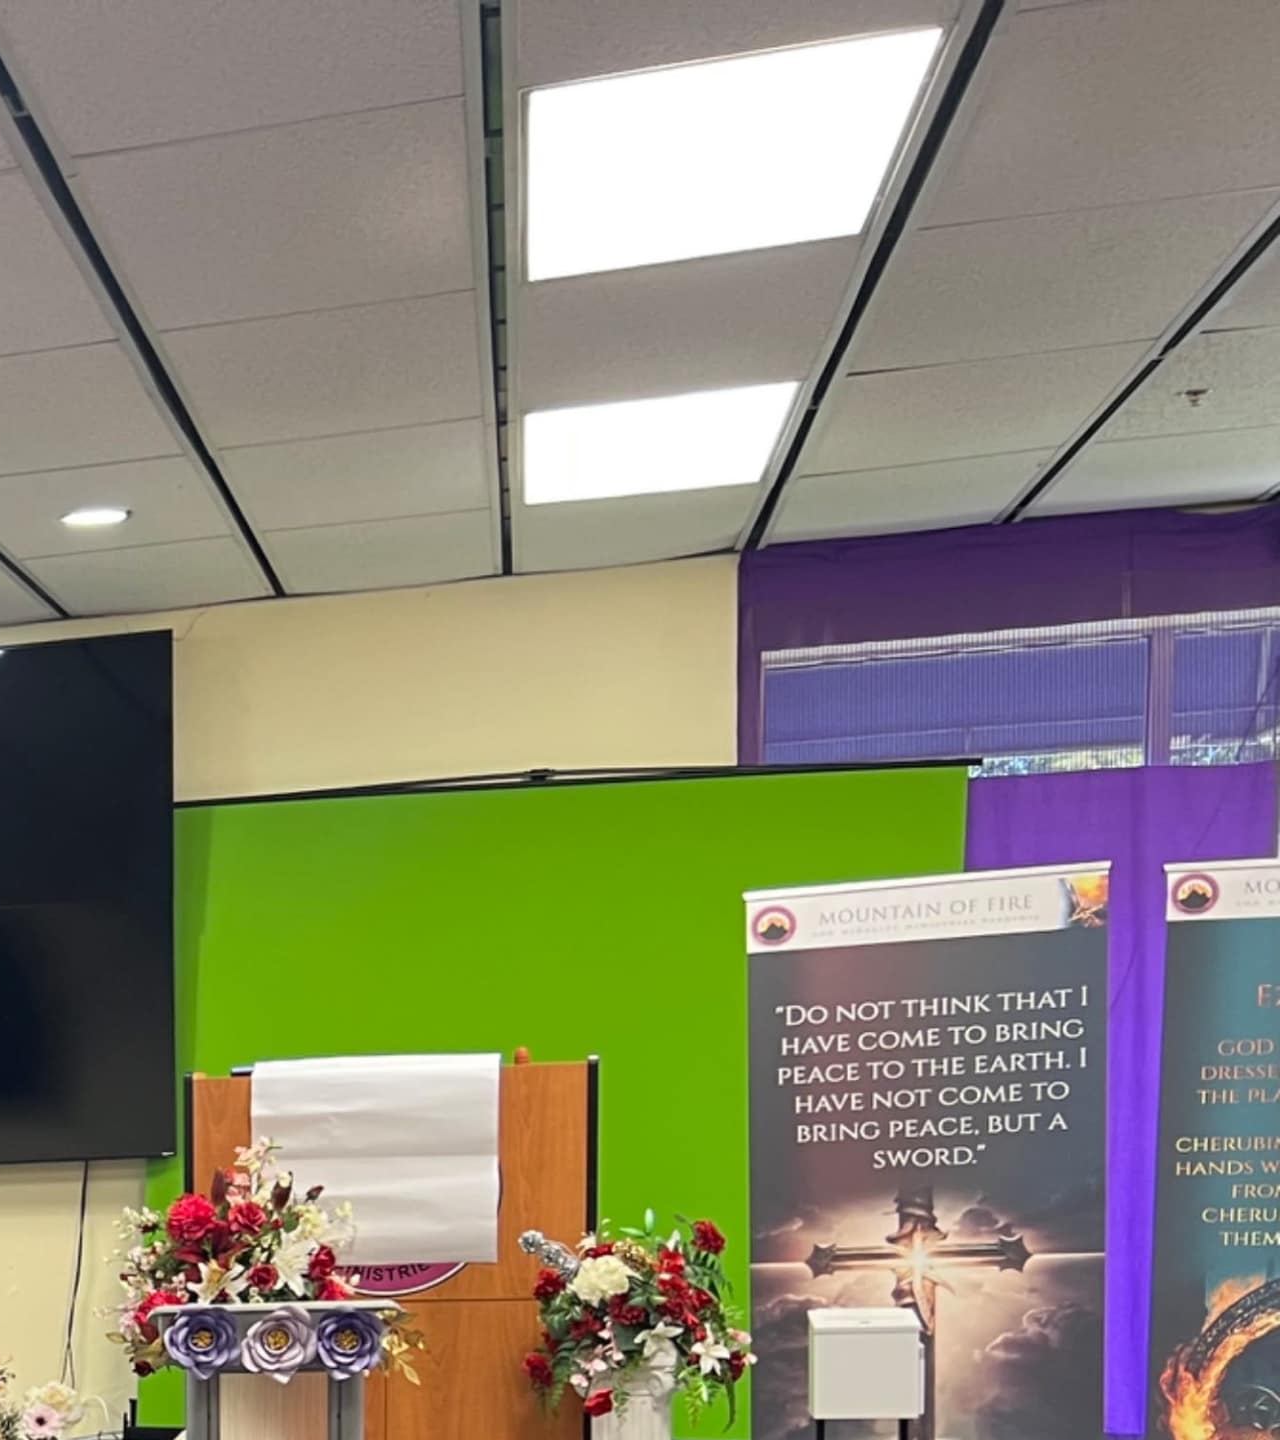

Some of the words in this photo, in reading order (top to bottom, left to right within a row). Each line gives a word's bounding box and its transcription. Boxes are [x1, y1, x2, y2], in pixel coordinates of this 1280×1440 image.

[819, 900, 942, 926] MOUNTAIN
[949, 898, 979, 915] OF
[986, 894, 1033, 913] FIRE
[835, 1001, 895, 1024] NOT
[901, 994, 991, 1018] THINK
[997, 988, 1073, 1012] THAT
[1080, 985, 1088, 1007] I
[781, 1034, 850, 1056] HAVE
[857, 1027, 941, 1051] COME
[947, 1024, 987, 1045] TO
[995, 1018, 1085, 1042] BRING
[1217, 1038, 1275, 1057] GOD
[777, 1063, 860, 1086] PEACE
[866, 1060, 905, 1081] TO
[911, 1056, 965, 1078] THE
[973, 1051, 1071, 1075] EARTH.
[1079, 1046, 1087, 1068] I
[795, 1092, 864, 1114] HAVE
[872, 1088, 931, 1110] NOT
[938, 1084, 1023, 1106] COME
[1029, 1081, 1071, 1101] TO
[1196, 1088, 1240, 1105] THE
[796, 1121, 880, 1144] BRING
[988, 1112, 1042, 1134] BUT
[1047, 1112, 1068, 1131] A
[1175, 1160, 1254, 1177] HANDS
